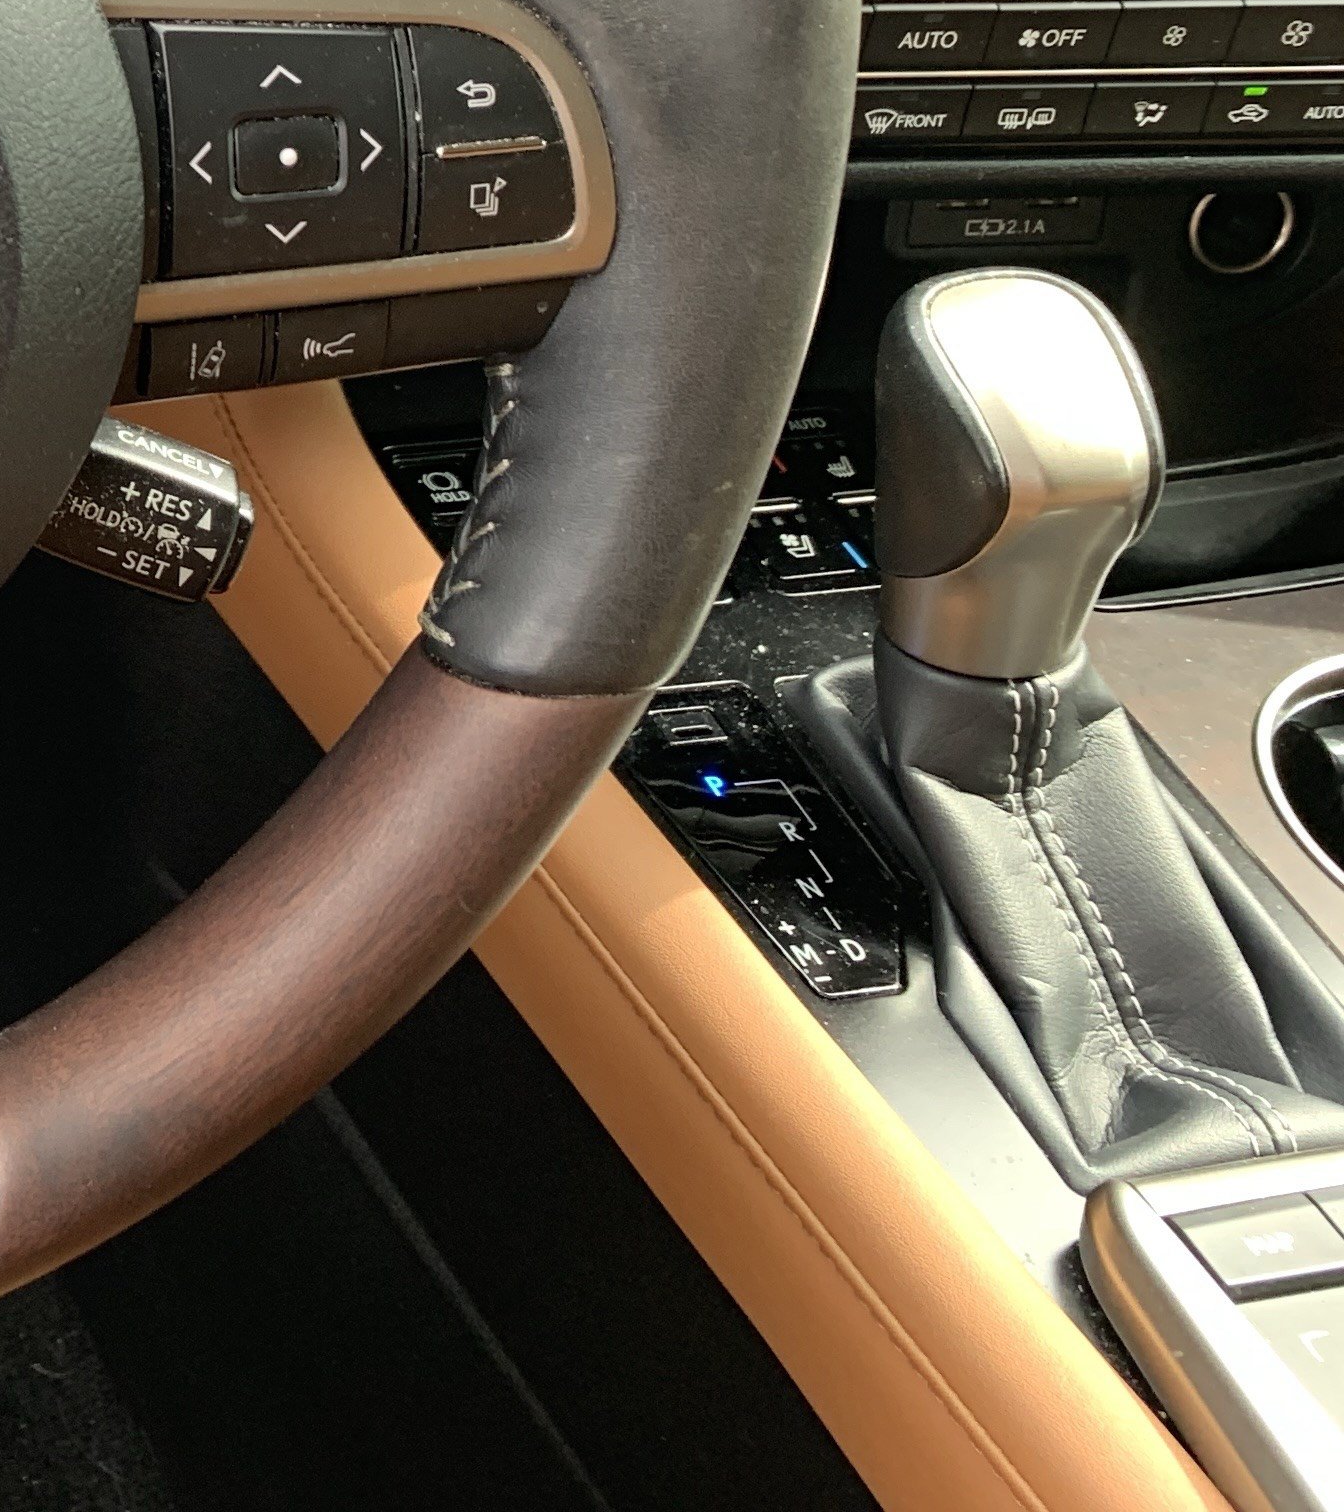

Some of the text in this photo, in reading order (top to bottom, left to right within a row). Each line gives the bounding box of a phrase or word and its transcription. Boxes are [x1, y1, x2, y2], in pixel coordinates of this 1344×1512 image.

[898, 30, 958, 49] AUTO
[1042, 28, 1087, 48] OFF
[895, 113, 947, 128] FRONT
[1303, 105, 1344, 120] AUTO
[1005, 219, 1045, 235] 2.1A
[117, 430, 210, 475] CANCEL
[144, 488, 193, 522] RES
[430, 490, 470, 503] HOLD
[69, 496, 121, 528] HOLD
[121, 550, 170, 580] SET
[704, 776, 723, 797] P
[779, 821, 805, 842] R
[796, 877, 824, 899] N
[789, 938, 867, 967] M D
